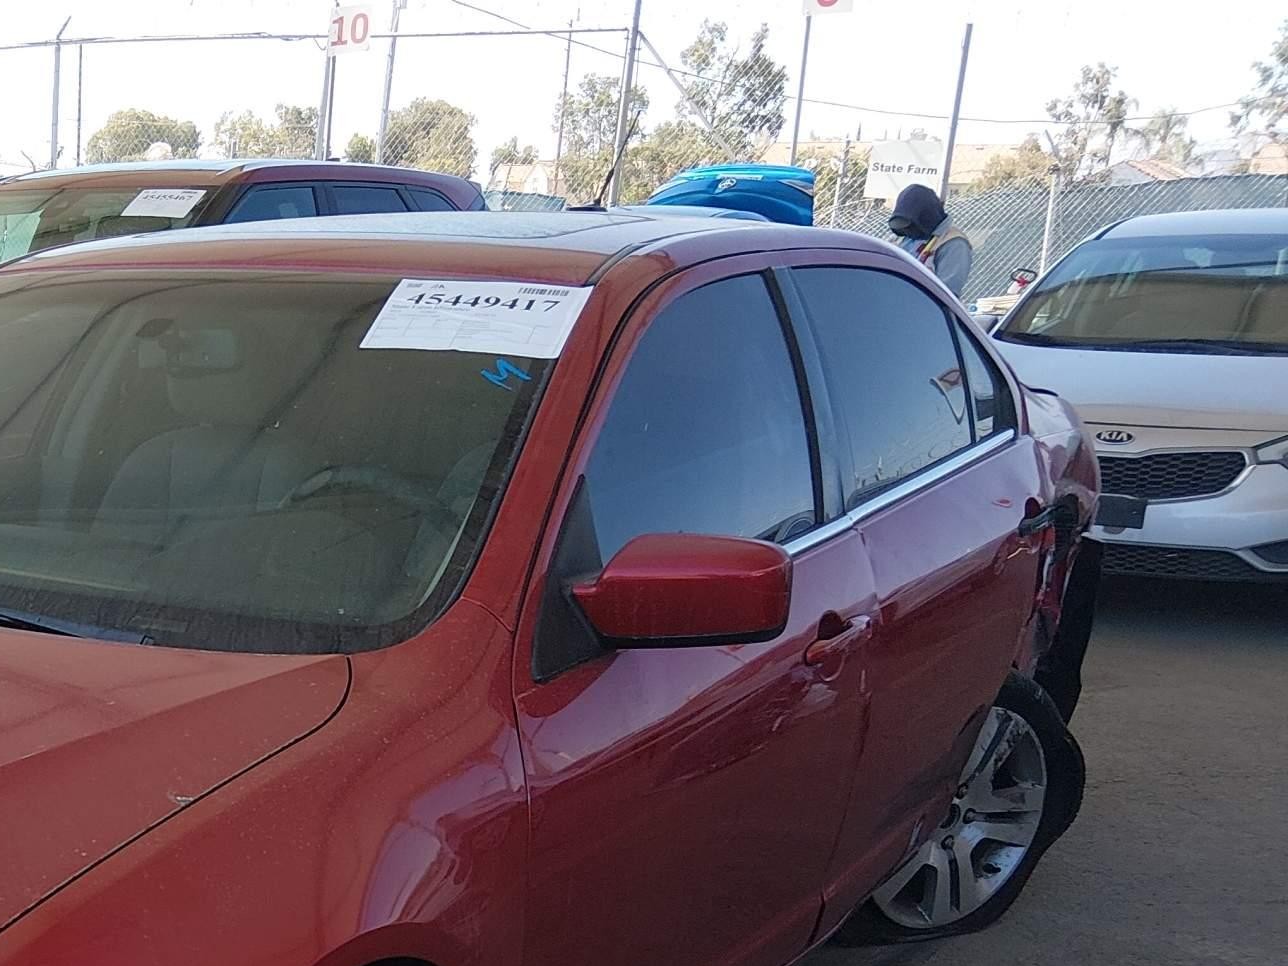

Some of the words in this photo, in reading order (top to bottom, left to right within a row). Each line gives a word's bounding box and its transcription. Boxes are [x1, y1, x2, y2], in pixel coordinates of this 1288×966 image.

[330, 13, 369, 47] 10
[872, 162, 903, 173] State
[906, 164, 938, 175] Farm
[406, 292, 560, 312] 45449417
[1100, 431, 1128, 441] KIA
